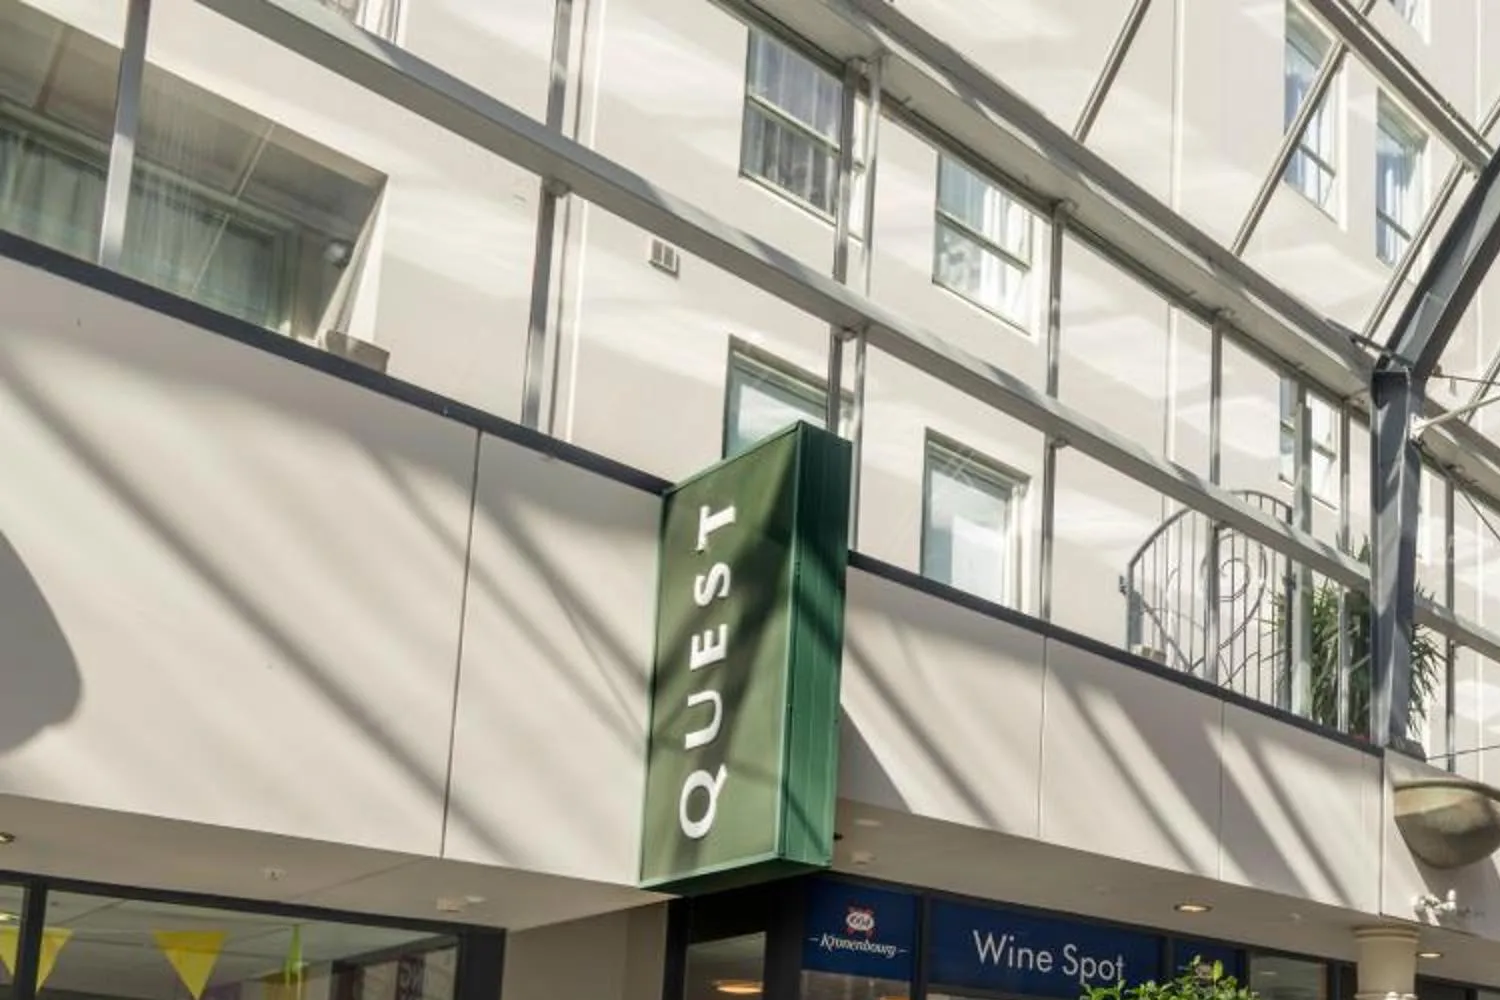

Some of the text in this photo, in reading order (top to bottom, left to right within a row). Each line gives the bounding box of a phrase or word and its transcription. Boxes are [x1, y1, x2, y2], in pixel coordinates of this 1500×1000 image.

[679, 504, 737, 840] QUEST
[819, 932, 898, 959] Kronenbourg
[973, 930, 1125, 984] Wine Spot
